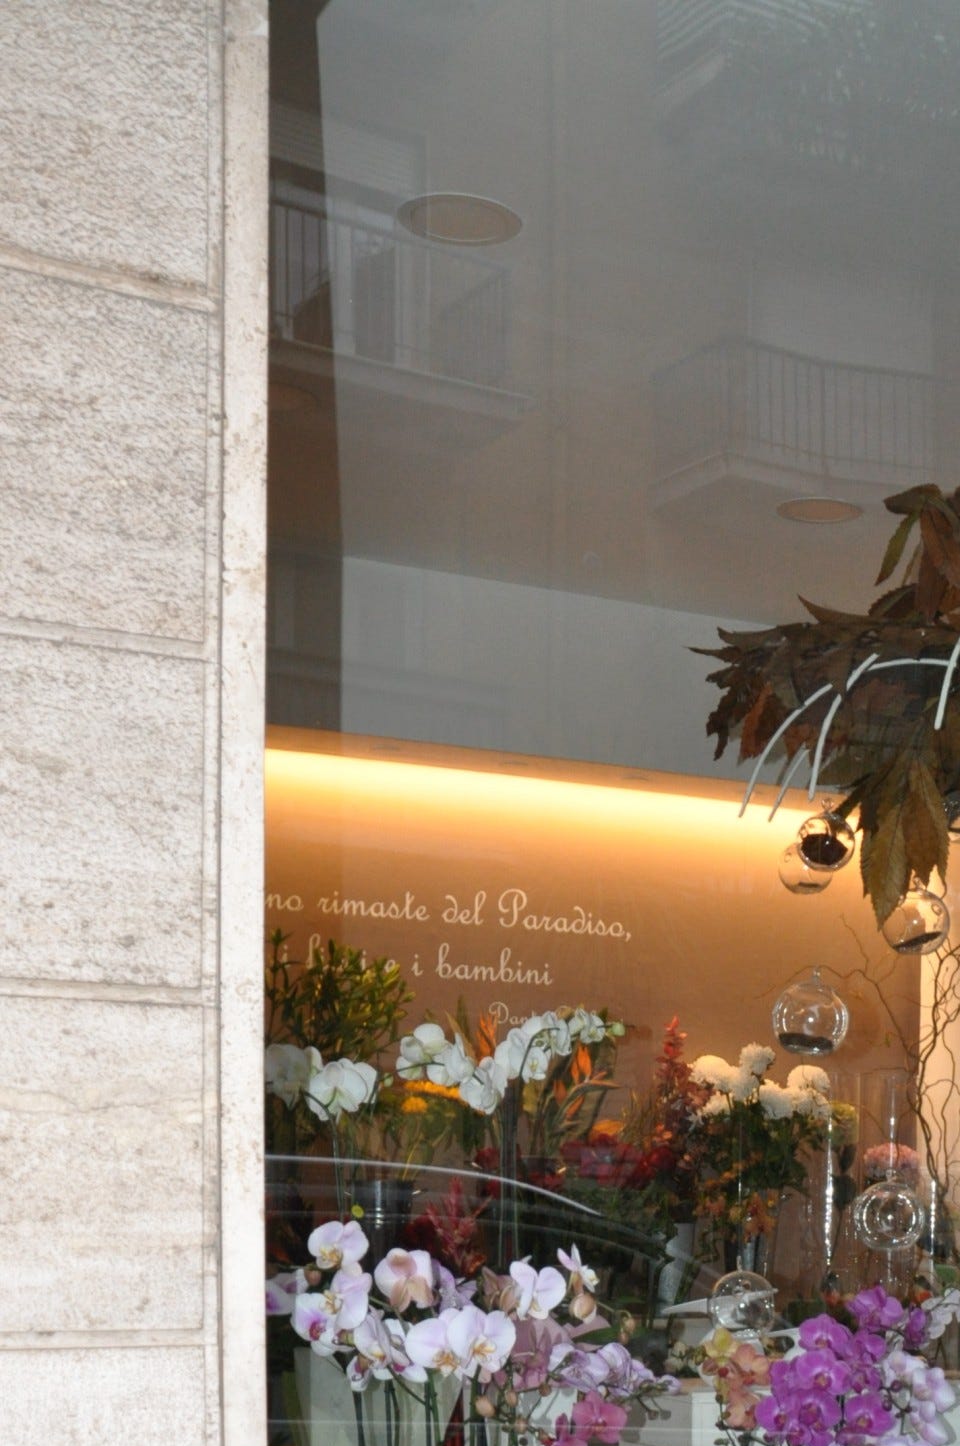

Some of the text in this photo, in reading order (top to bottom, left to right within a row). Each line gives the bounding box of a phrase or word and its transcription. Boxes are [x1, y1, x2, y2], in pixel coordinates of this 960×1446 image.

[317, 890, 431, 921] rimaste
[441, 890, 487, 925] del
[498, 888, 632, 942] Paradiso,
[411, 954, 424, 977] i
[436, 942, 553, 985] bambini
